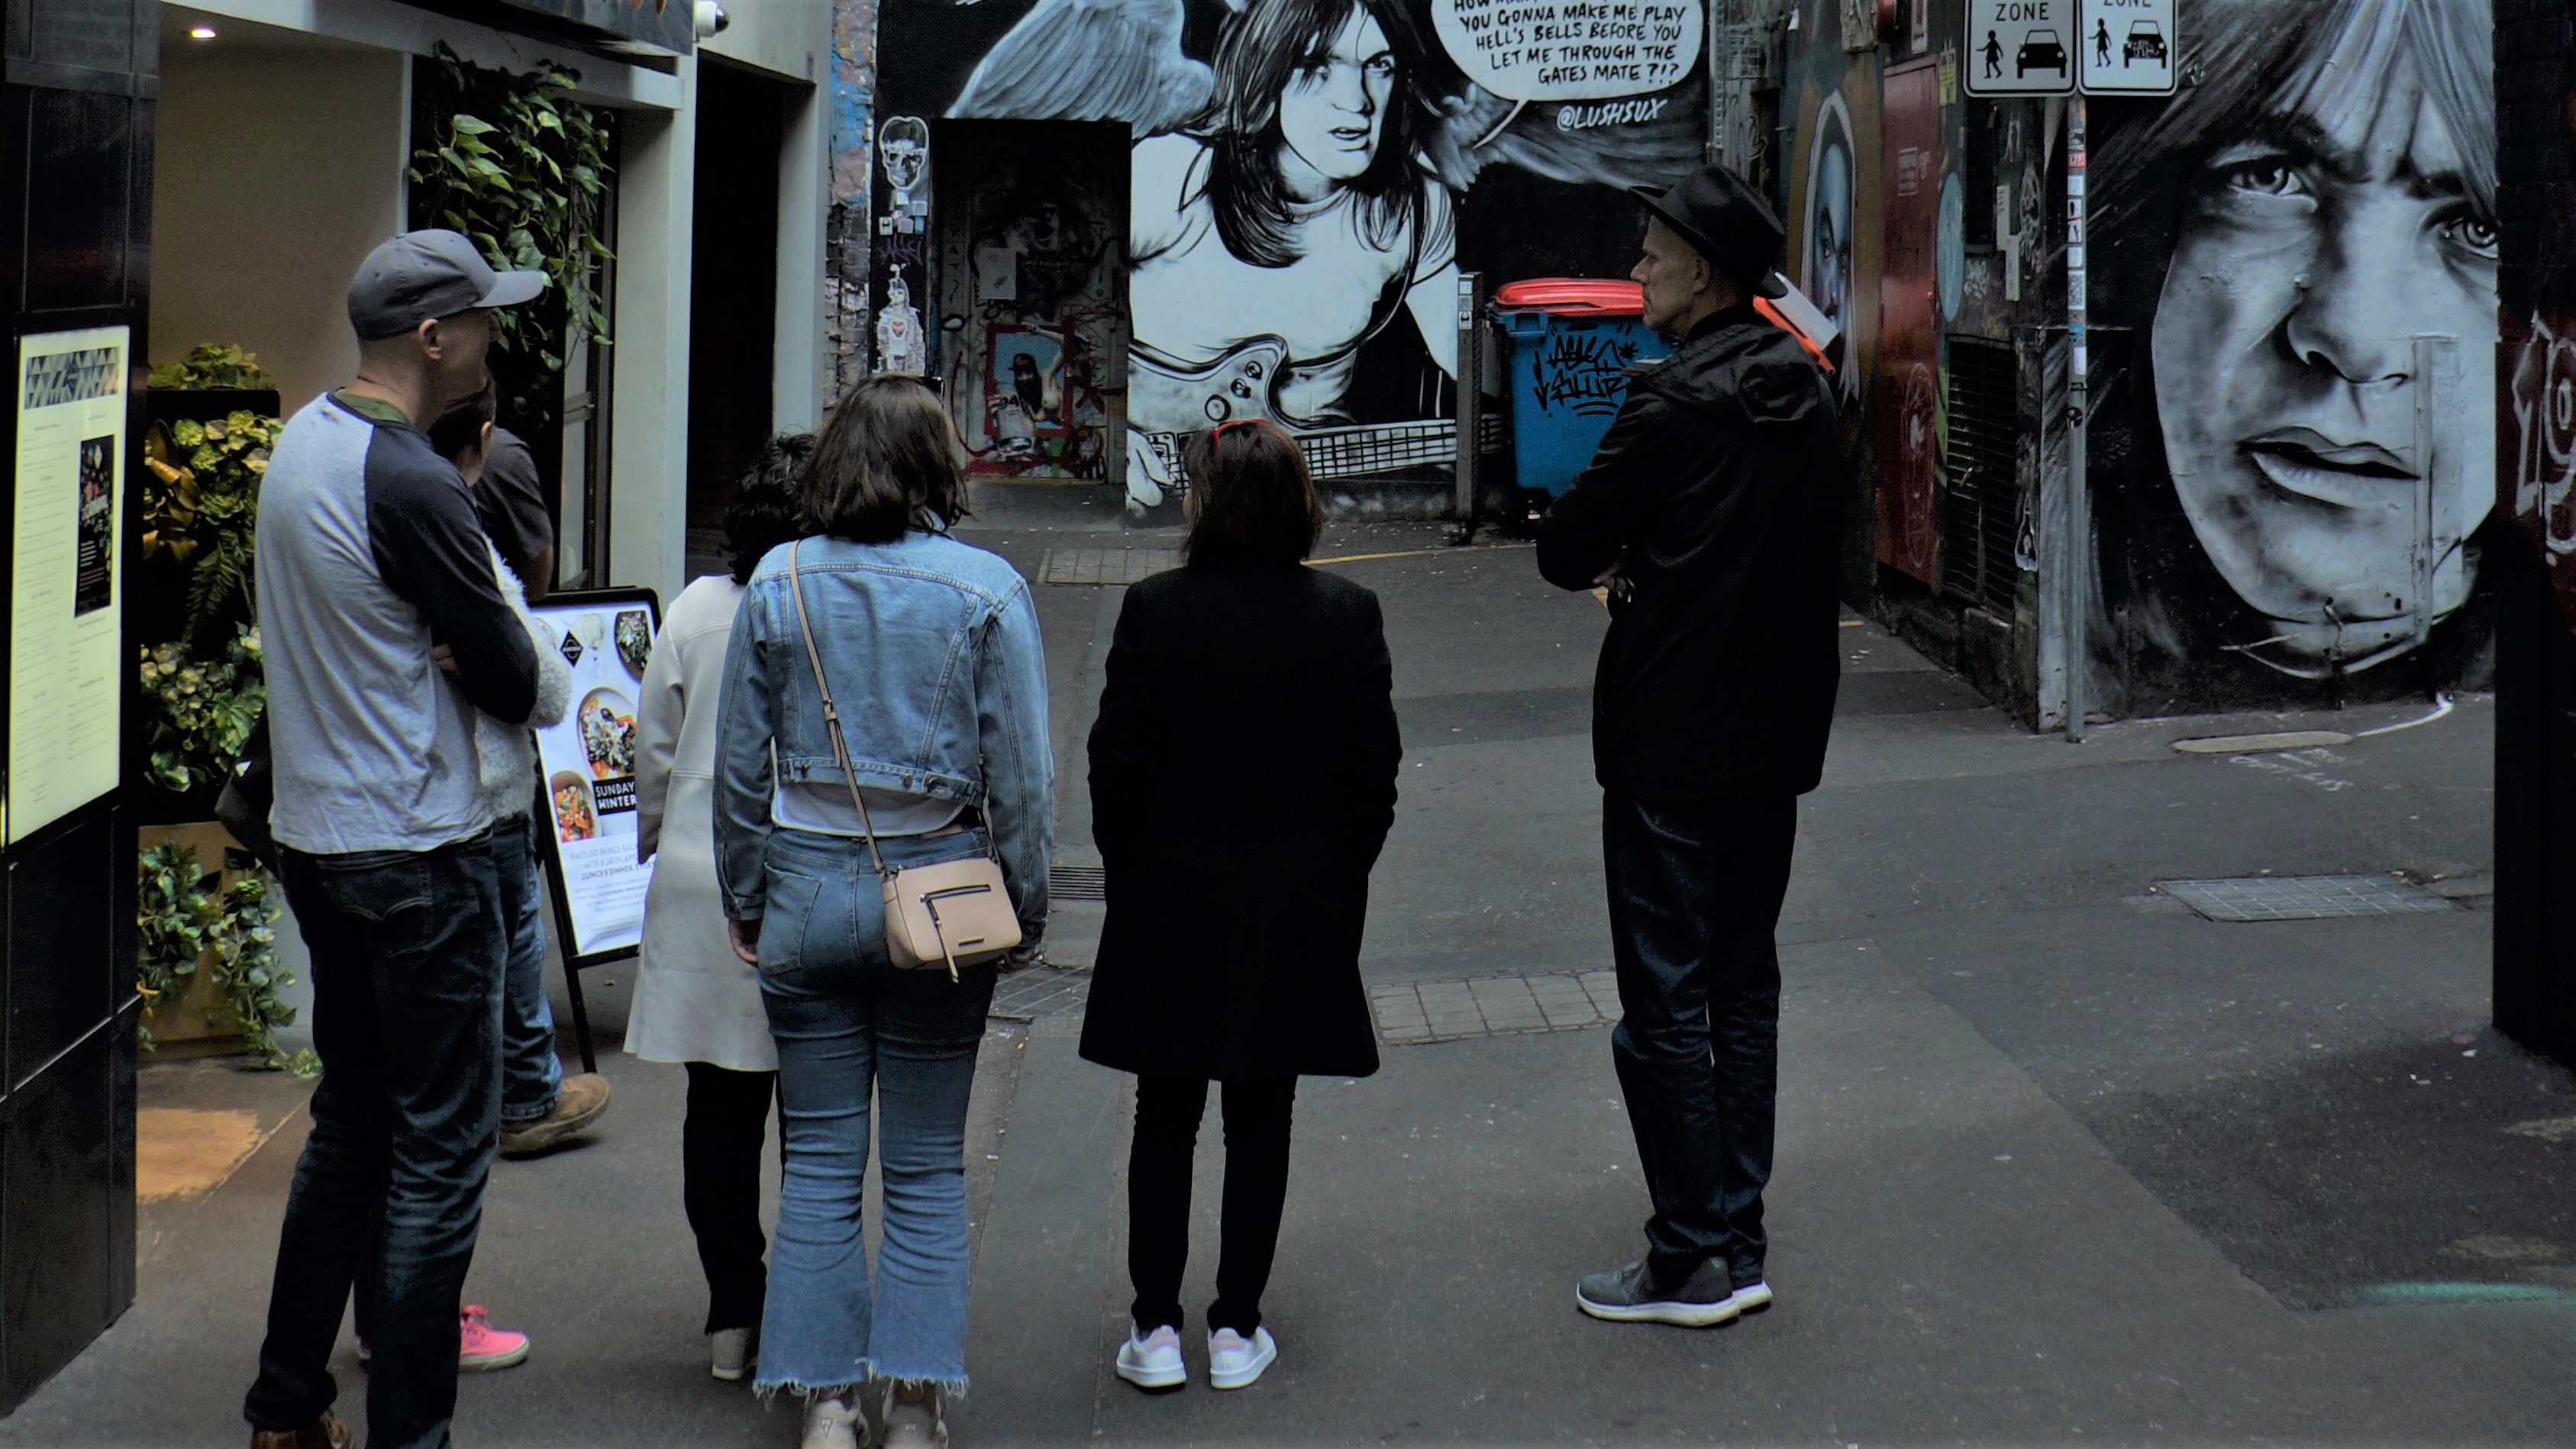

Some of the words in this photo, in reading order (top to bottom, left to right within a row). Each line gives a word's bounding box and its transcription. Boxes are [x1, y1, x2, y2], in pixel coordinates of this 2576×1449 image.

[1459, 13, 1491, 34] YOU
[1497, 6, 1555, 27] GONNA
[1563, 3, 1609, 21] MAKE
[1612, 4, 1637, 21] ME
[1643, 6, 1686, 24] PLAY
[1995, 3, 2049, 21] ZONE
[1476, 27, 1525, 51] HELL'S
[1534, 22, 1583, 43] BELLS
[1589, 21, 1646, 40] BEFORE
[1654, 24, 1681, 41] YOU
[1491, 49, 1522, 70] LET
[1526, 47, 1554, 64] ME
[1558, 44, 1636, 63] THROUGH
[1641, 44, 1677, 60] THE
[1538, 65, 1587, 86] GATES
[1593, 63, 1641, 82] MATE
[1647, 63, 1680, 86] ?!?
[1556, 97, 1668, 132] @LUSHSUX
[596, 781, 635, 798] SUNDAY
[597, 793, 638, 810] WINTER
